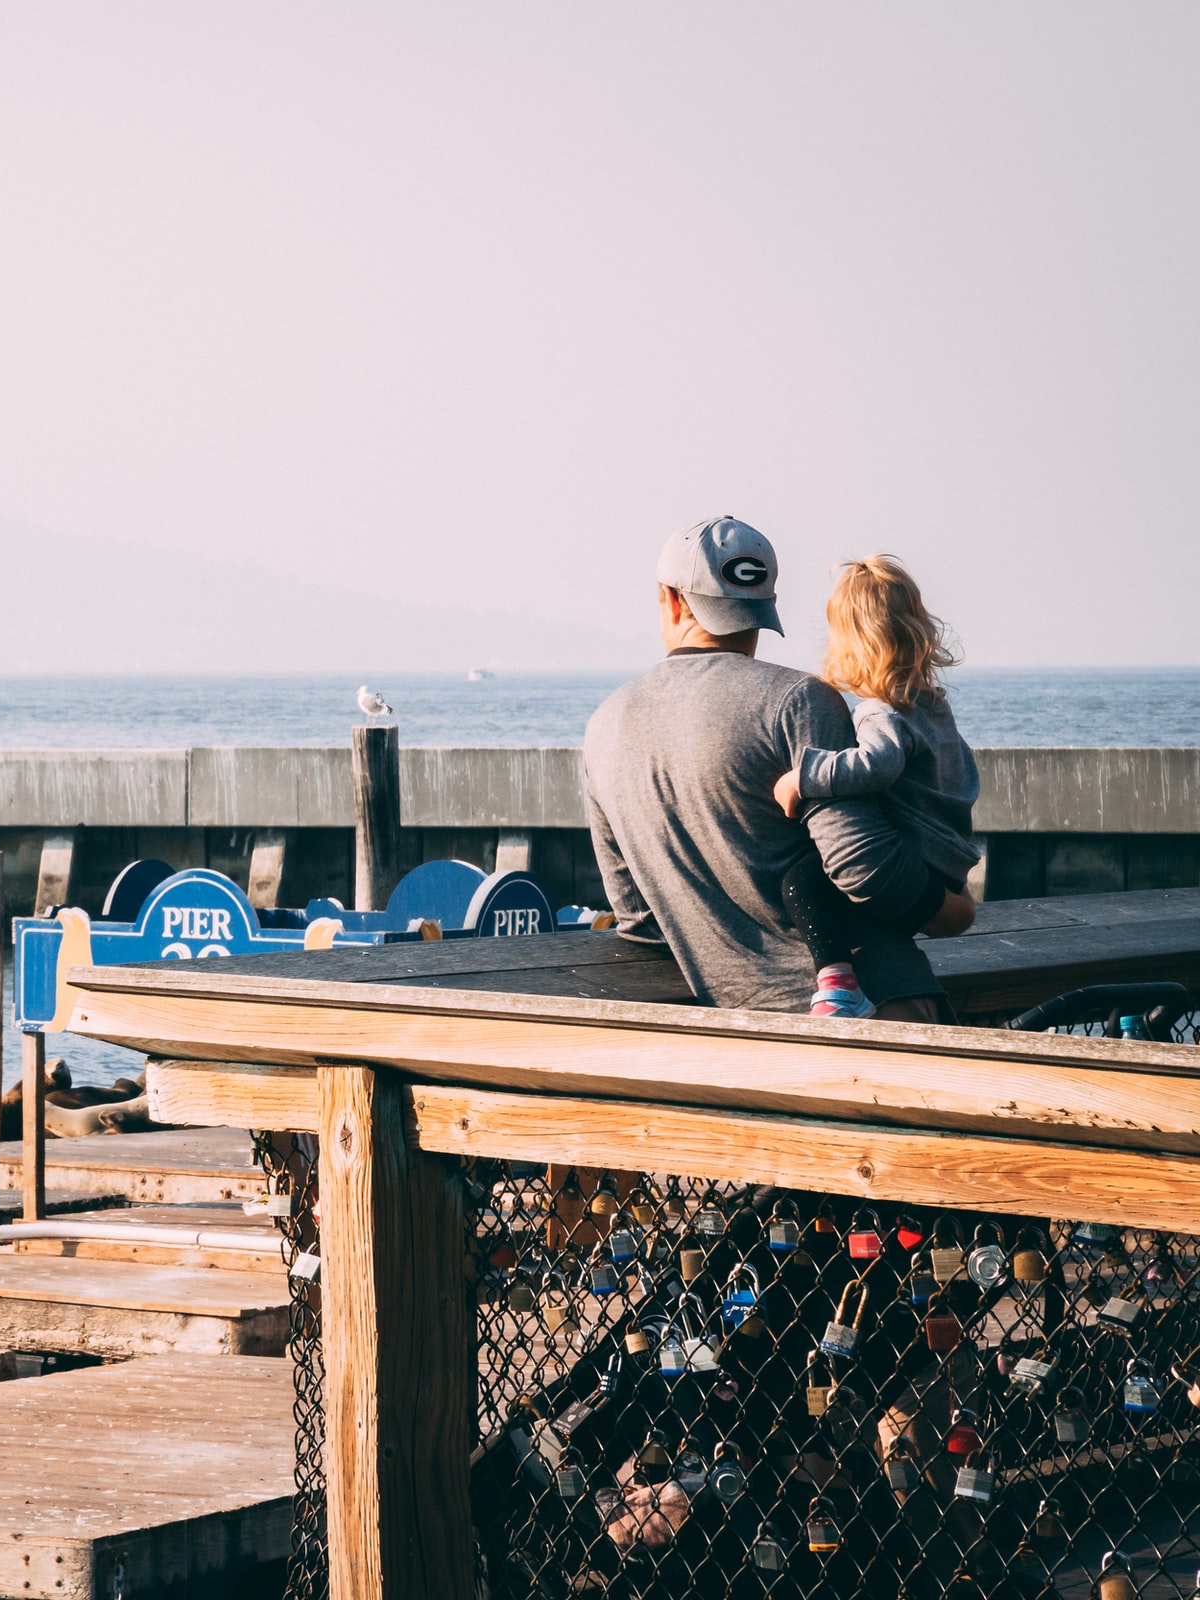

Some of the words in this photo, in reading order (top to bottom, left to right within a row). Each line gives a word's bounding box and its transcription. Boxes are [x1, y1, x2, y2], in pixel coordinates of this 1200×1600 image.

[734, 562, 767, 581] G
[161, 906, 234, 940] PIER
[493, 908, 541, 937] PIER
